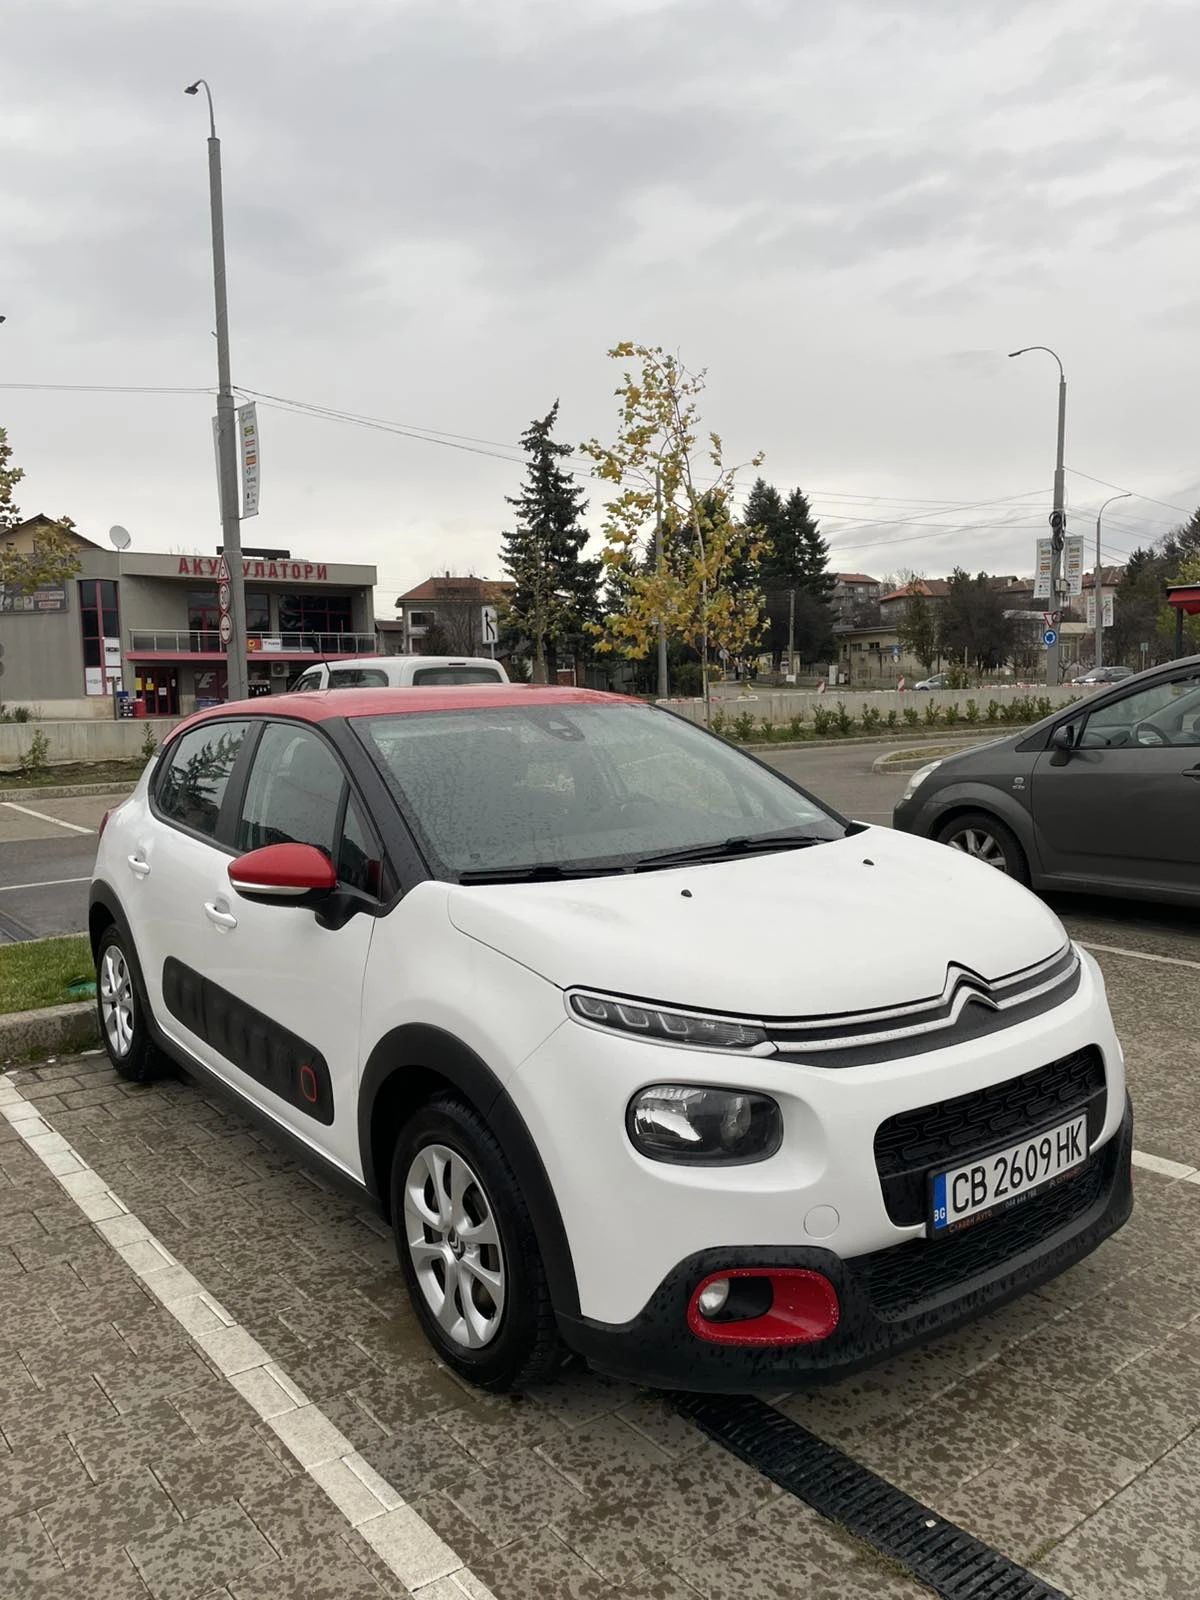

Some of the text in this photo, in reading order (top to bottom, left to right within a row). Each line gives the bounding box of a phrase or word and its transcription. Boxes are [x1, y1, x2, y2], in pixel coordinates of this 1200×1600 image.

[178, 557, 328, 581] АКУУЛАТОРИ
[952, 1120, 1083, 1214] CB 2609 HK
[934, 1207, 946, 1222] BG
